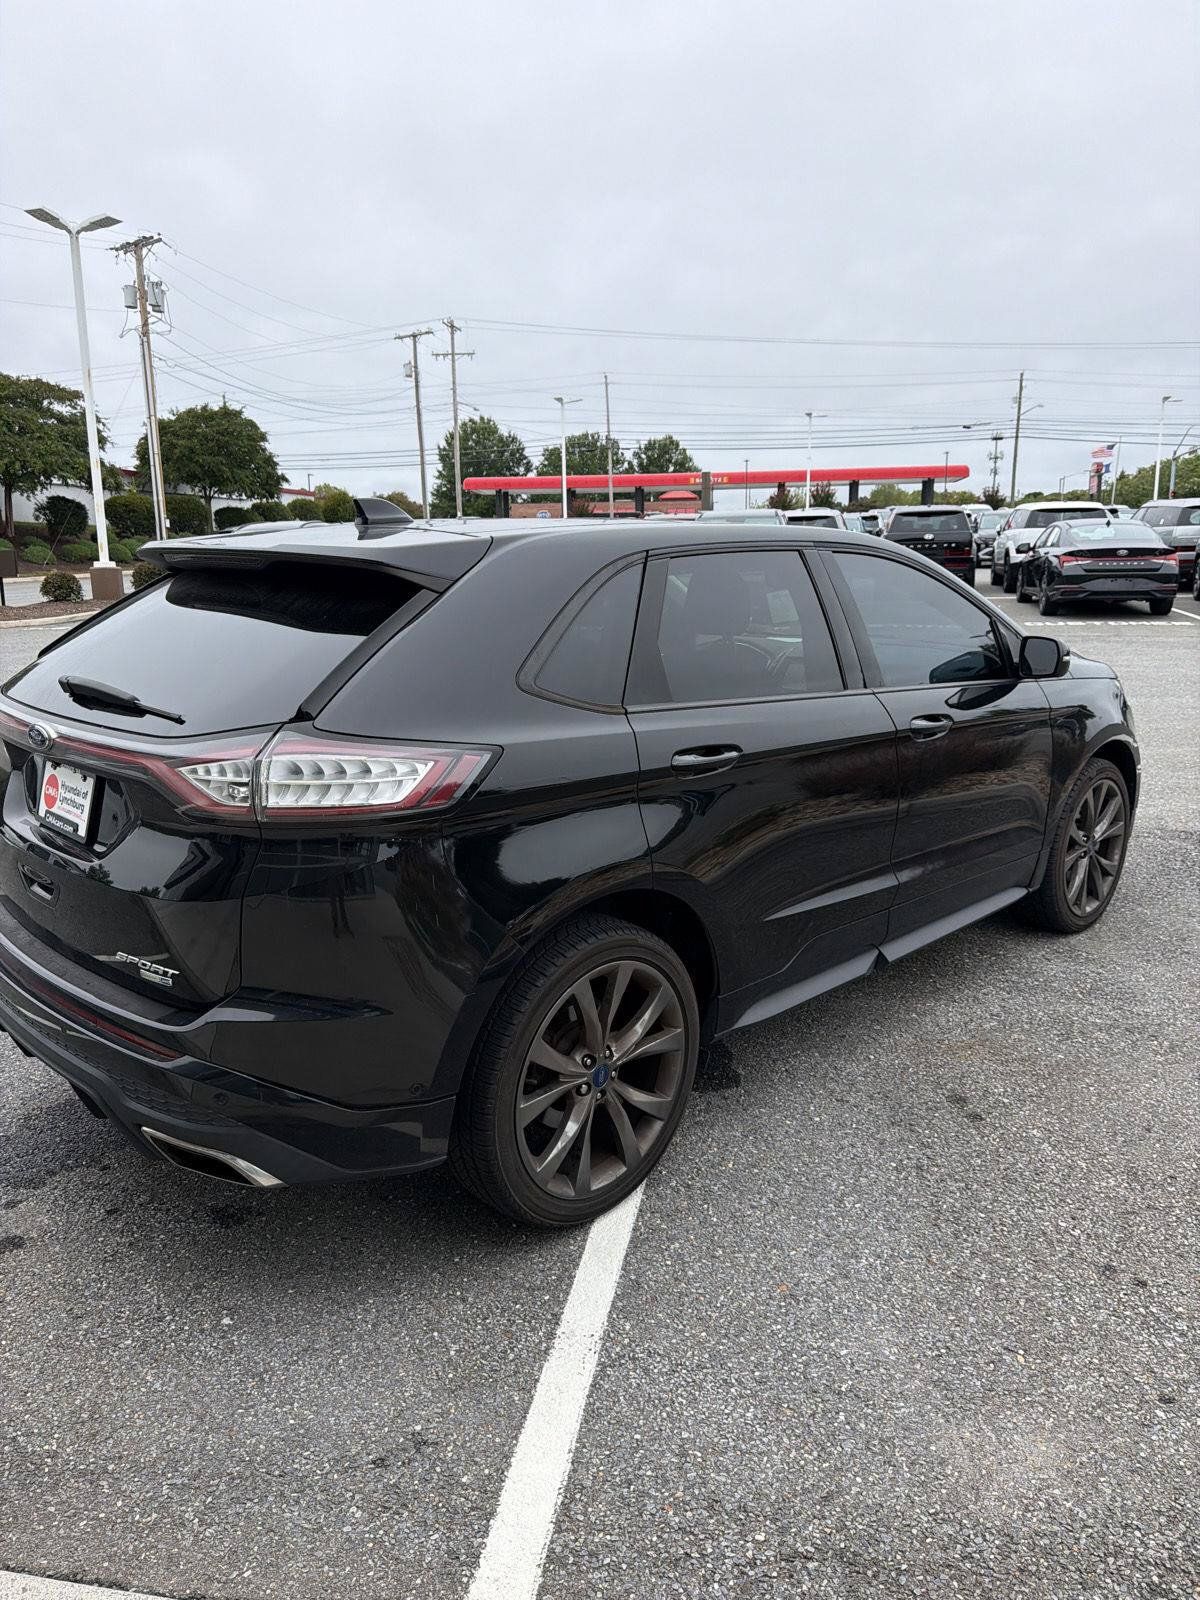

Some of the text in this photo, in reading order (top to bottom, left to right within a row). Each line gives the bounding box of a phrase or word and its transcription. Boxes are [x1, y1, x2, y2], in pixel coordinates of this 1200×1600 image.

[61, 780, 89, 800] Hyundai of
[59, 793, 85, 814] Lynchburg
[116, 951, 180, 977] SPORT
